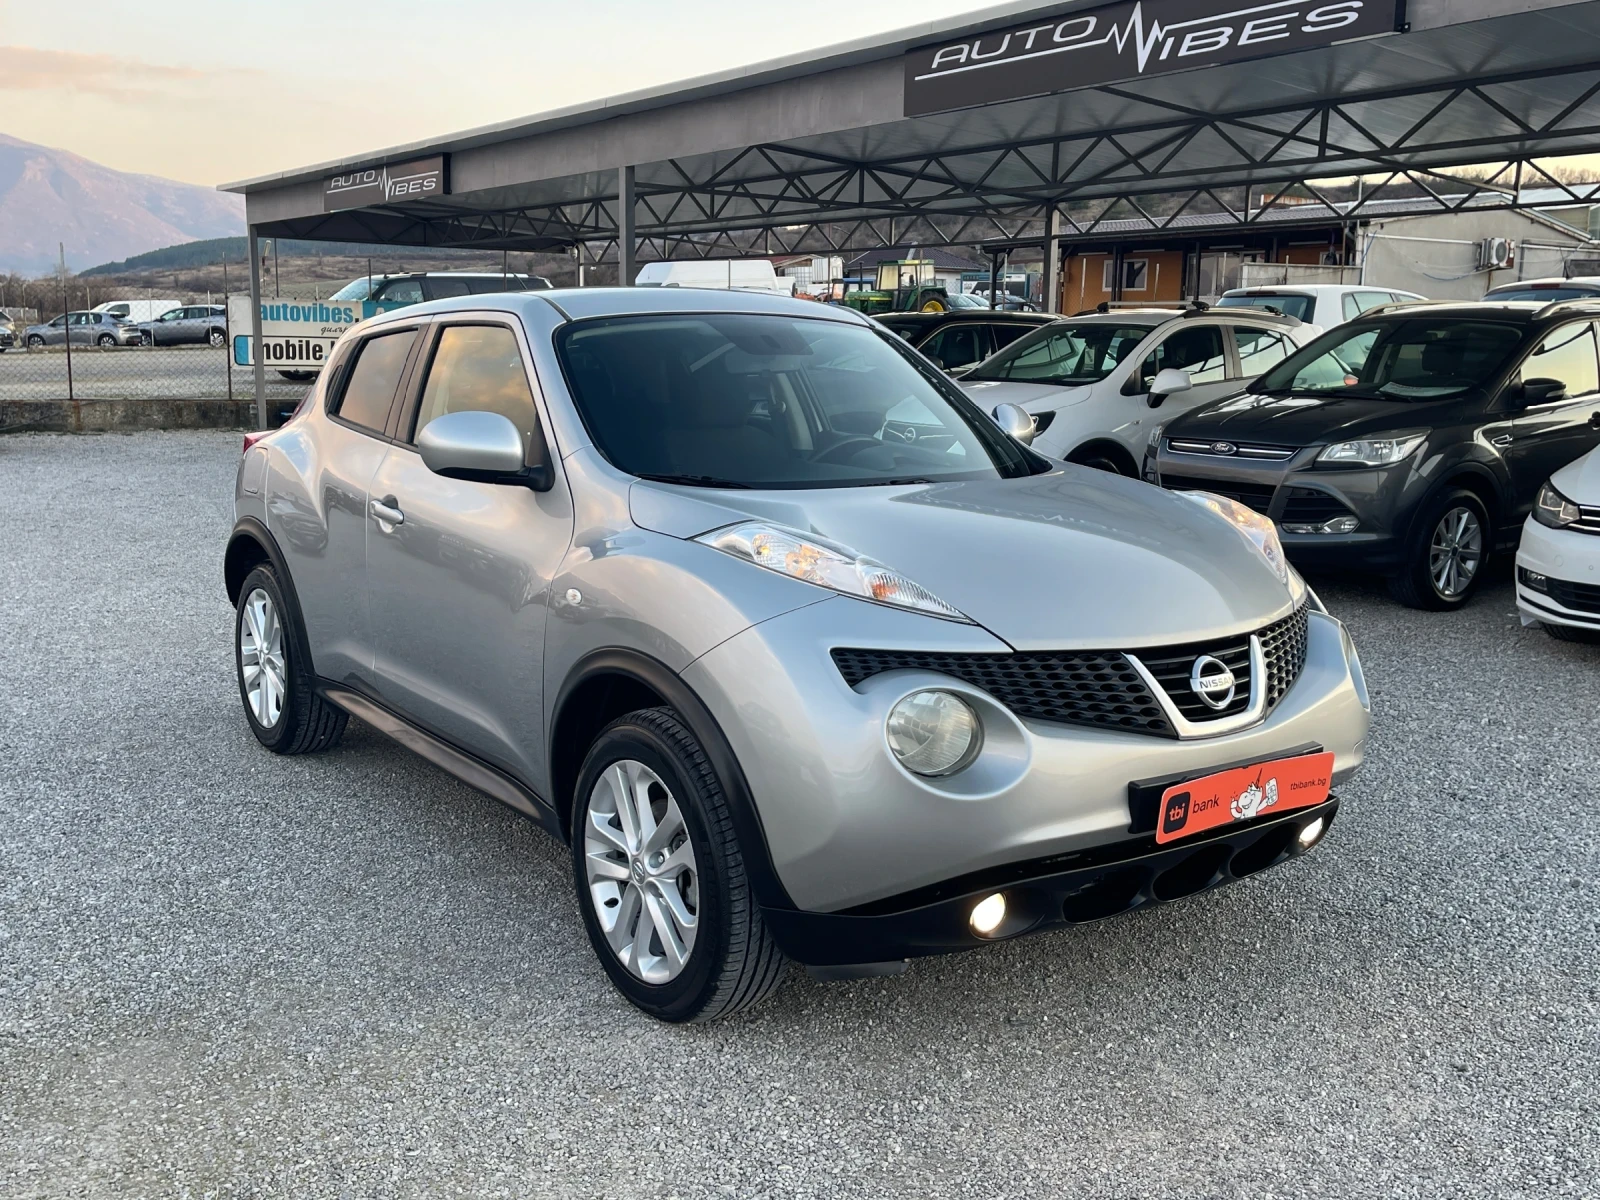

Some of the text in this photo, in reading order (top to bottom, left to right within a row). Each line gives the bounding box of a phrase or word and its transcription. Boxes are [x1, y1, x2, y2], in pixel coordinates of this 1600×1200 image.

[931, 15, 1098, 69] AUTO
[330, 169, 376, 188] AUTO
[1199, 676, 1233, 689] NISSAN
[1290, 777, 1327, 791] tbibank.bg
[1169, 794, 1220, 821] tbi bank
